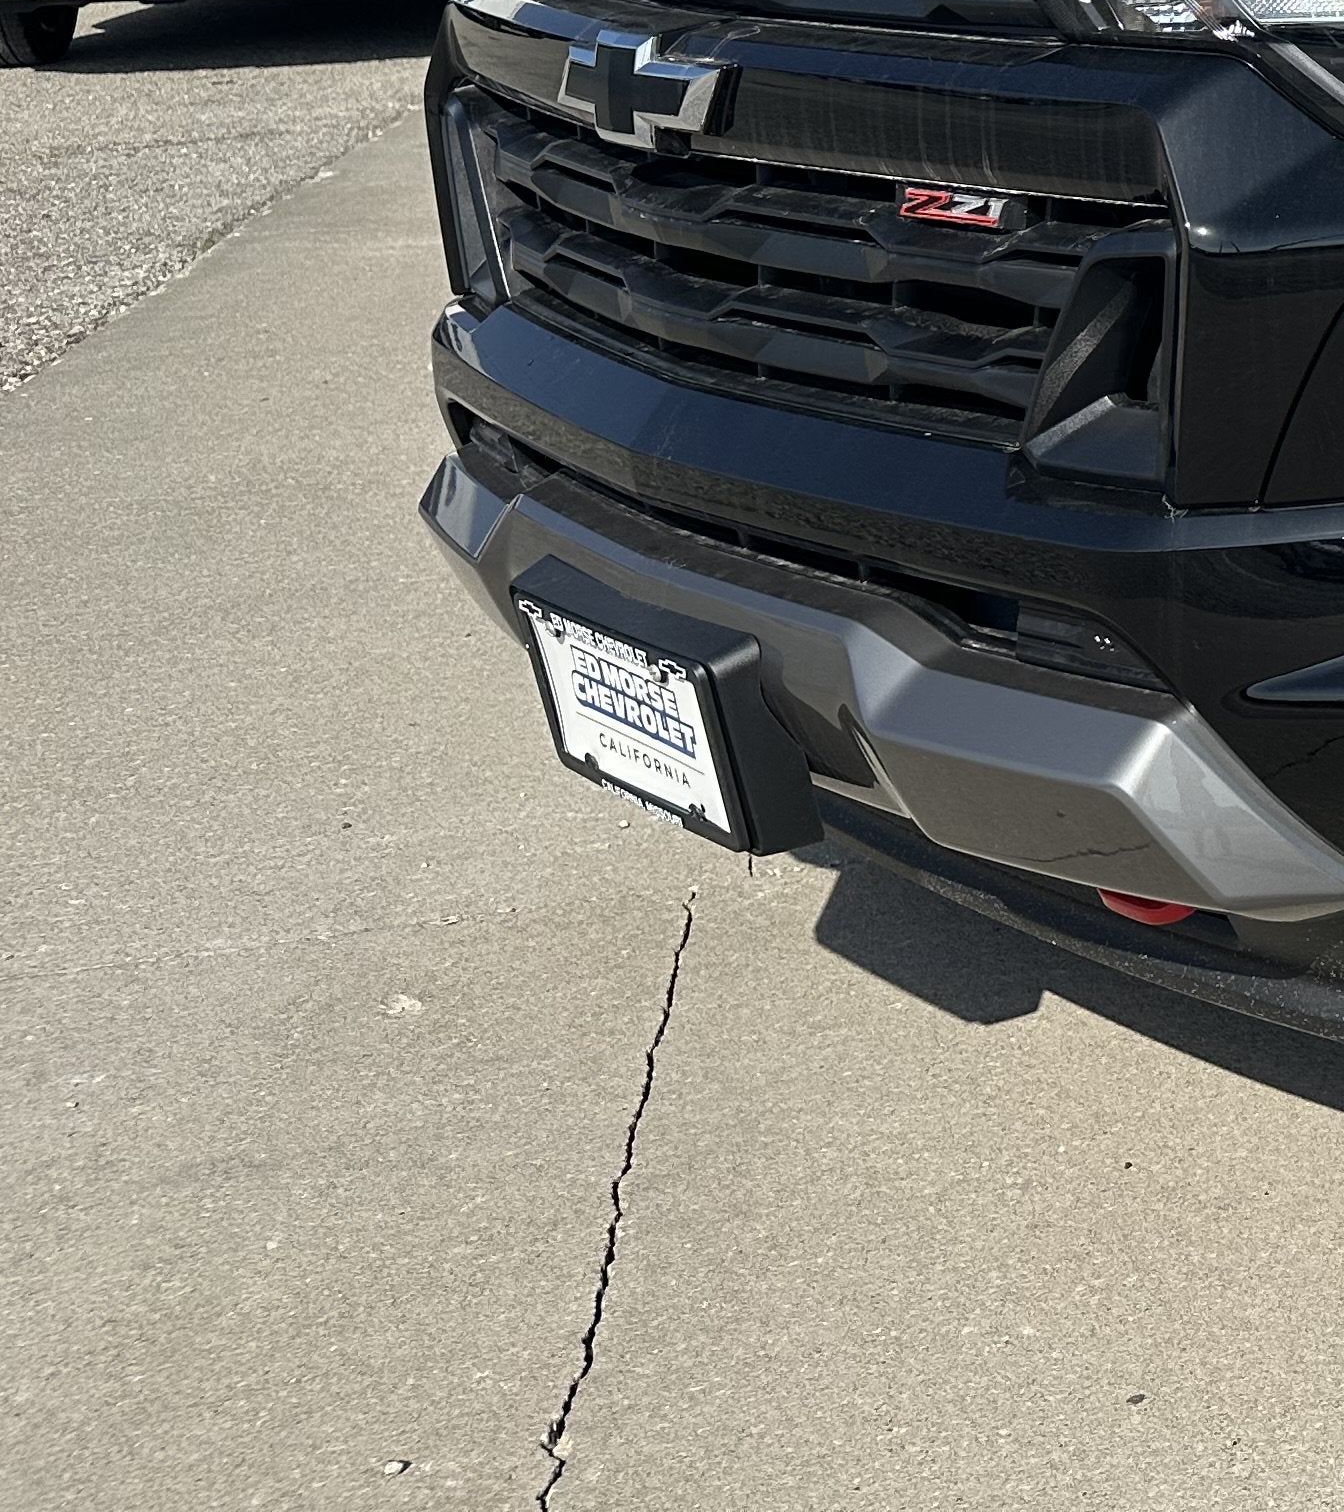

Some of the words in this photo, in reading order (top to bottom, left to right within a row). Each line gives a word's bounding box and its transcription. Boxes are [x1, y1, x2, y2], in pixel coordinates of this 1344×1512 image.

[900, 188, 1009, 227] Z71
[563, 617, 597, 648] MORSE
[594, 632, 649, 668] CHEVROLET
[571, 645, 601, 681] ED
[572, 670, 696, 759] CHEVROLET
[600, 657, 680, 719] MORSE
[599, 732, 692, 788] CALIFORNIA
